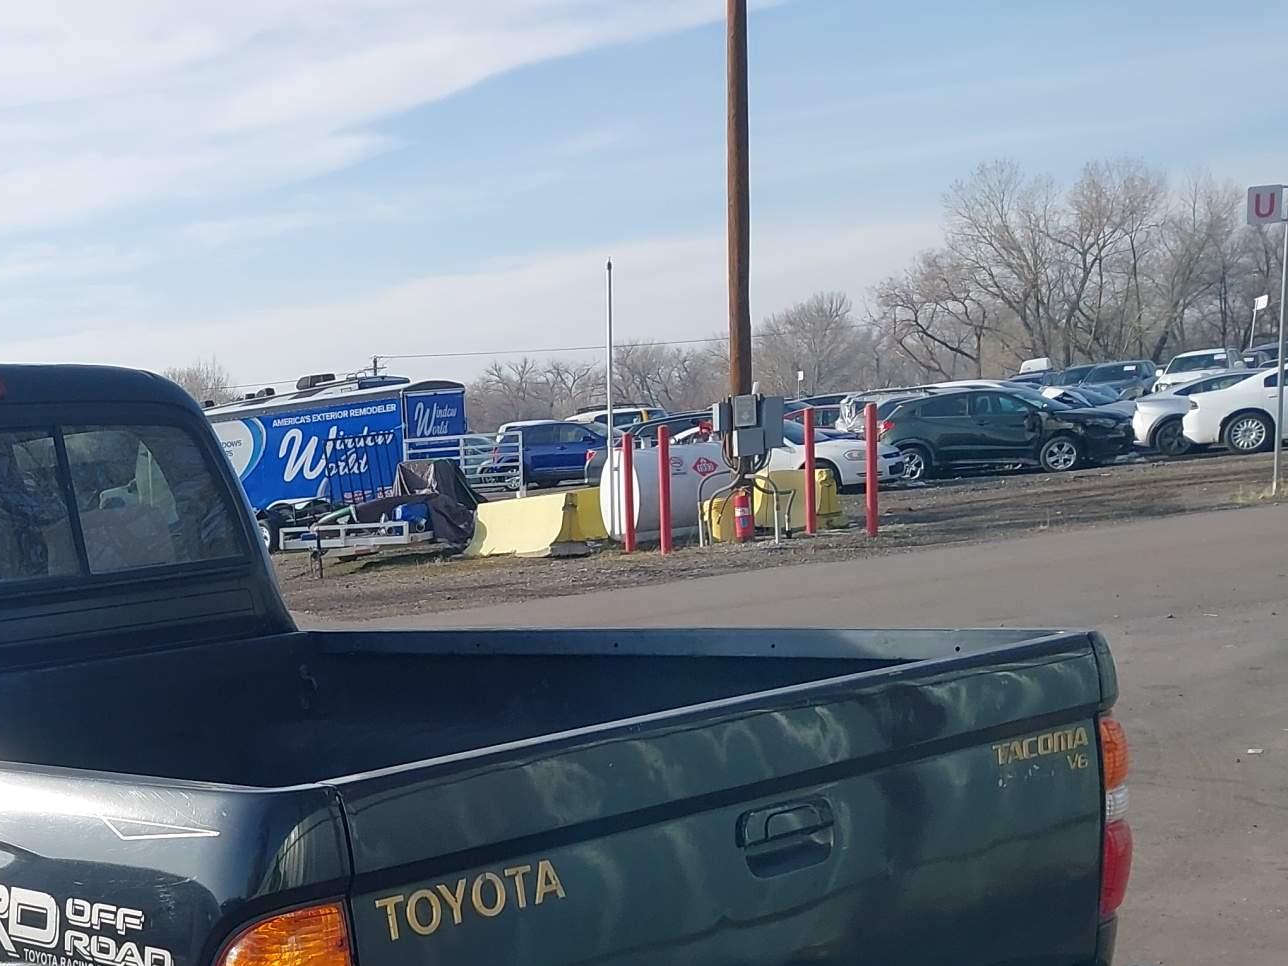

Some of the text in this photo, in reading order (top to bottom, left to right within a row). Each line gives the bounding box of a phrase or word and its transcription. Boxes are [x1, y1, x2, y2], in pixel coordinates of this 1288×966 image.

[1255, 191, 1275, 219] U
[272, 403, 397, 428] AMERICA'S EXTERIOR REMODELER
[414, 400, 458, 437] Window
[278, 425, 395, 482] Window
[992, 727, 1089, 766] TACOMA
[1067, 753, 1089, 769] V6
[65, 897, 145, 935] OFF
[375, 859, 566, 941] TOYOTA
